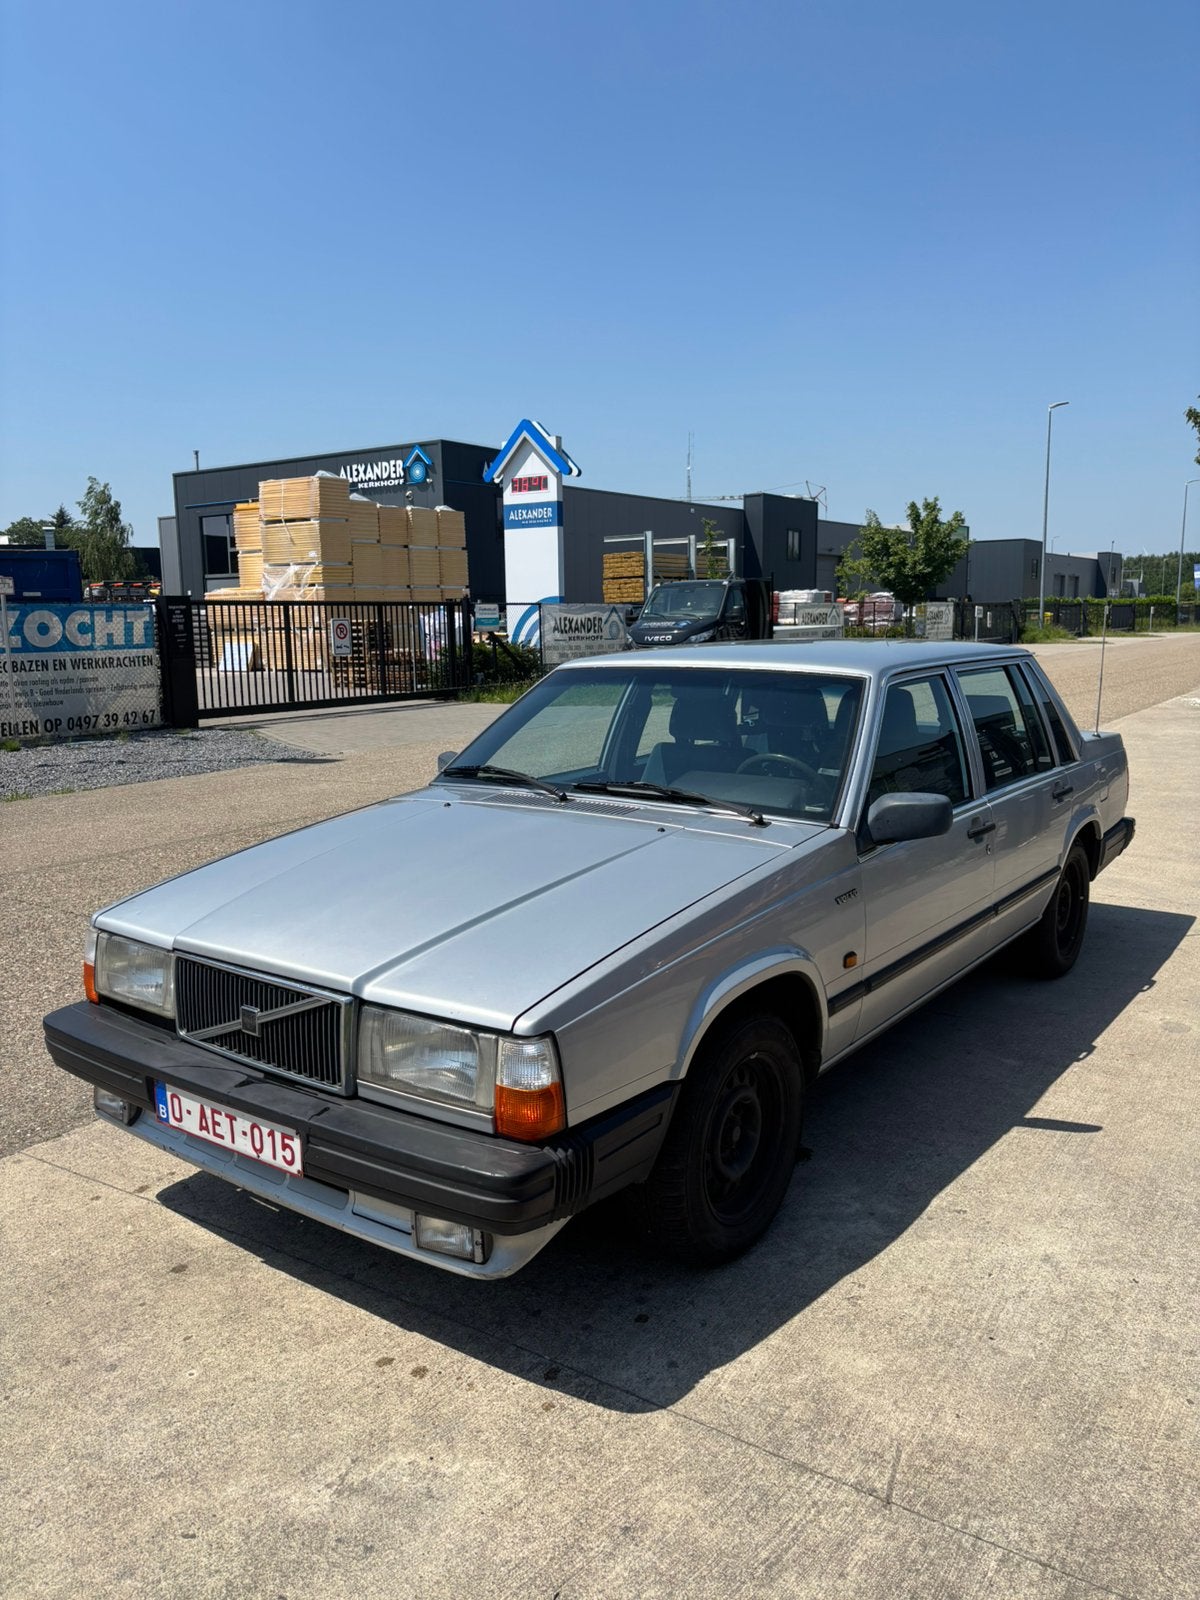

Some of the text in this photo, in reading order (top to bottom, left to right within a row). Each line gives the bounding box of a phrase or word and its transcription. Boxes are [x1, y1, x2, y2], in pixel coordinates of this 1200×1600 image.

[340, 460, 404, 483] ALEXANDER
[358, 479, 404, 489] KERKHOFF
[509, 507, 552, 521] ALEXANDER
[553, 616, 603, 634] ALEXANDER
[53, 659, 67, 671] EN
[71, 655, 153, 671] WERKKRACHTEN
[44, 718, 63, 733] OP
[67, 715, 99, 731] 0497
[104, 713, 119, 728] 39
[123, 711, 138, 725] 42
[142, 709, 156, 723] 67
[159, 1104, 167, 1119] B
